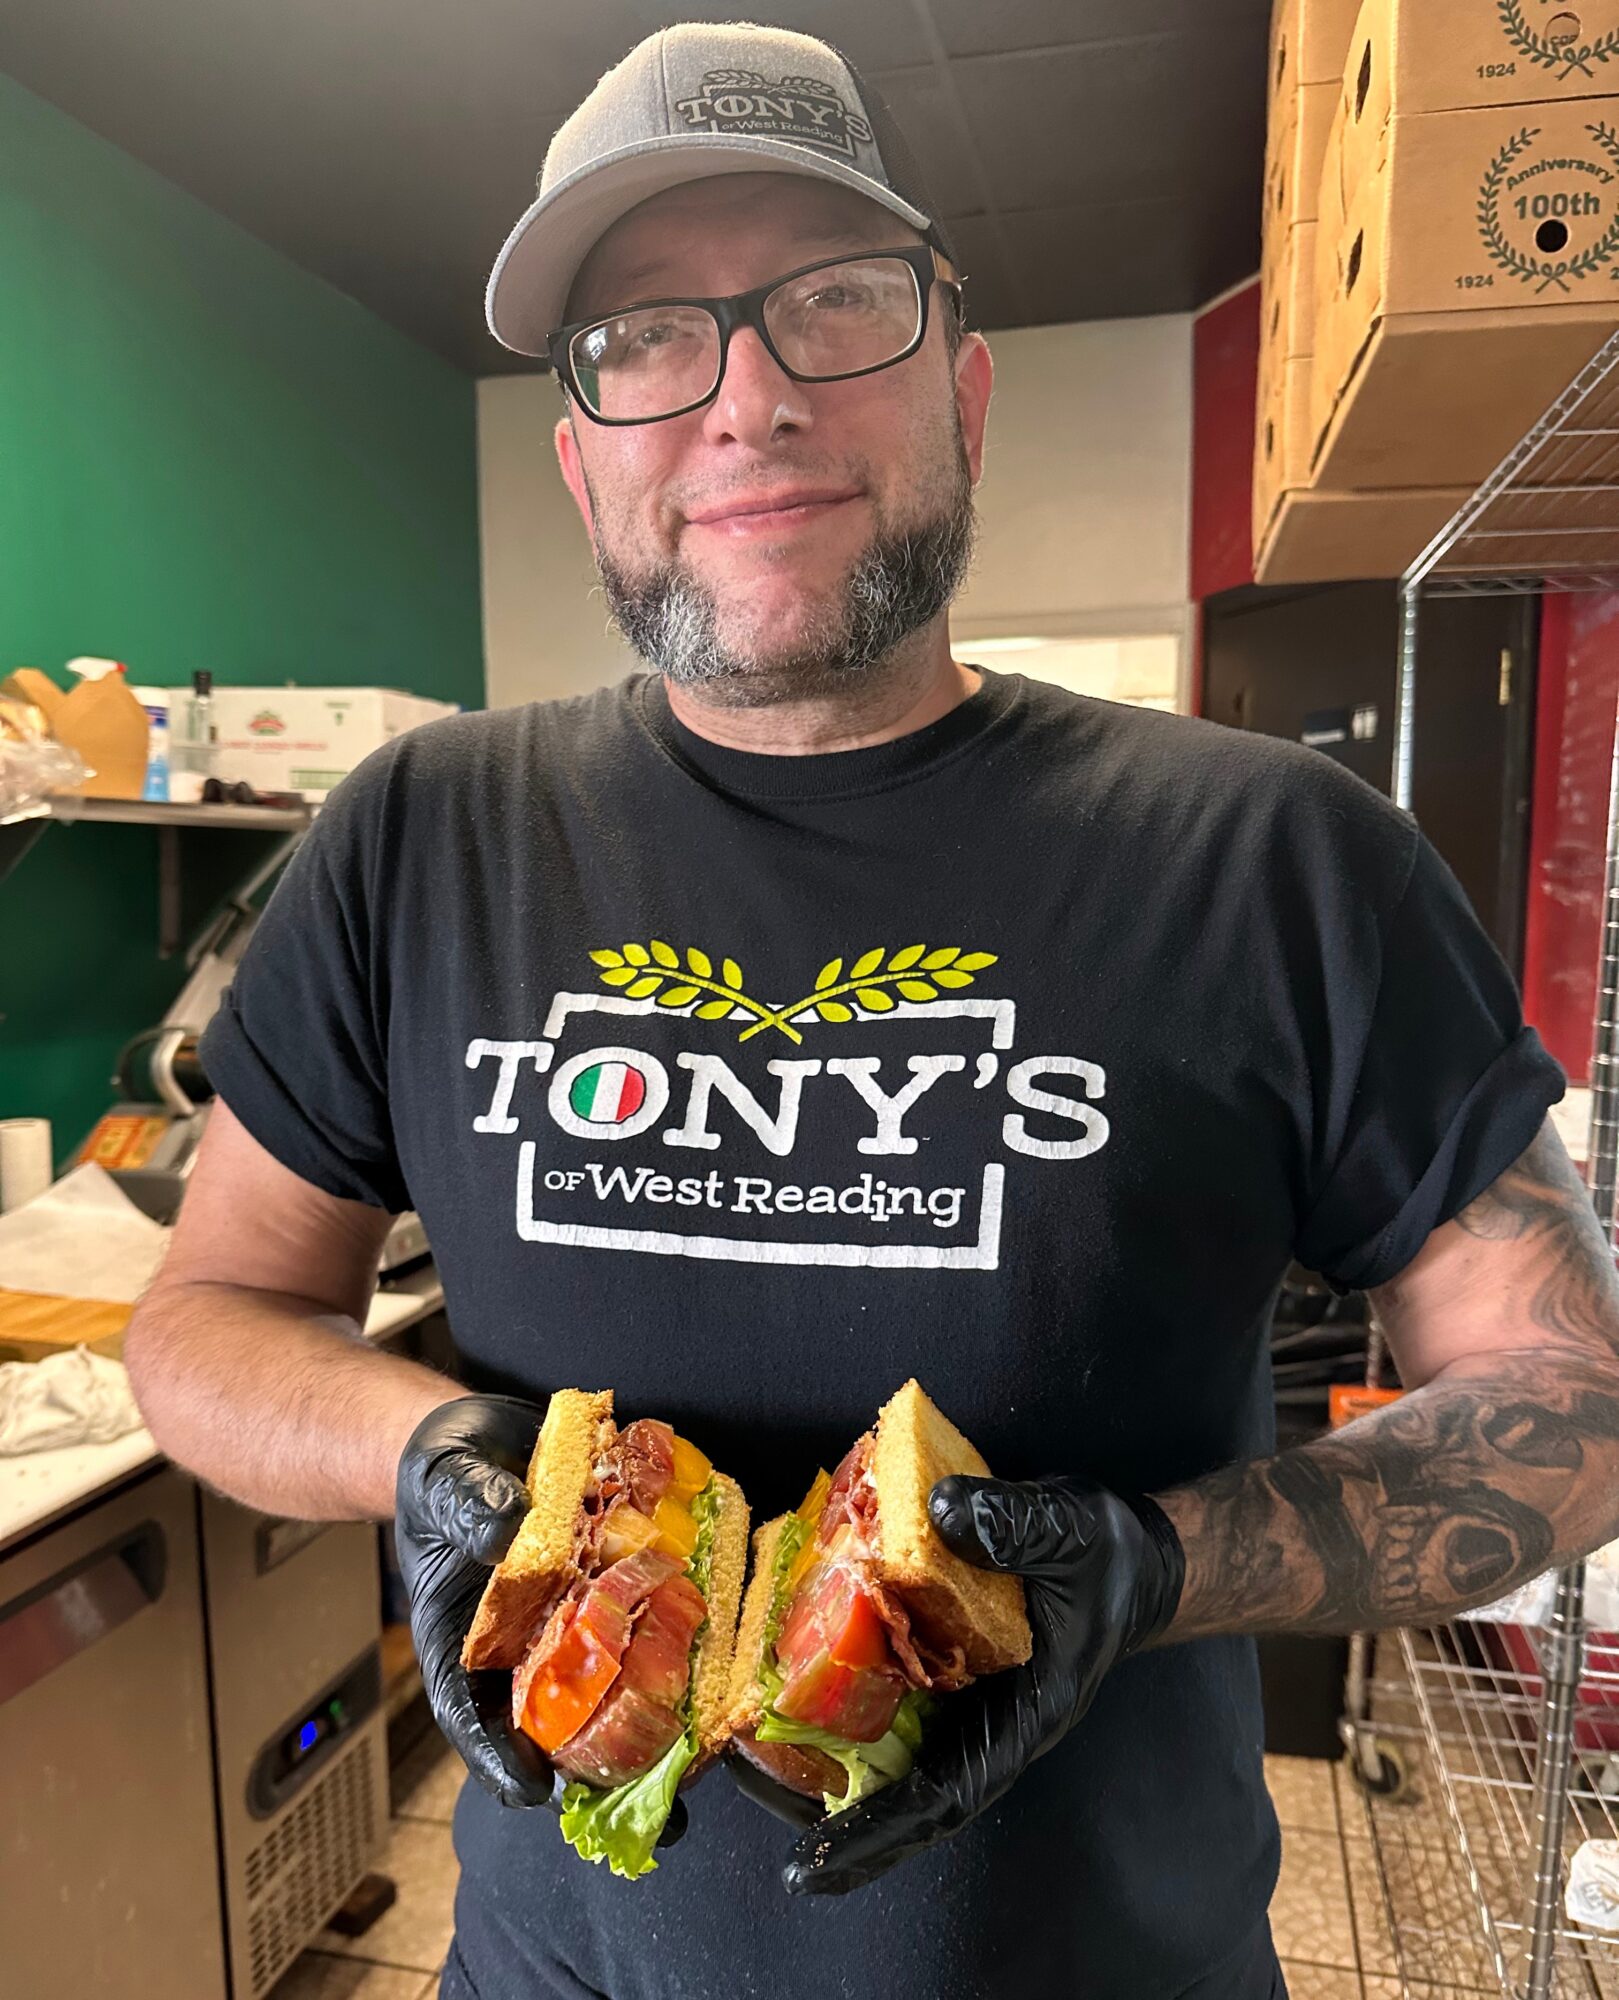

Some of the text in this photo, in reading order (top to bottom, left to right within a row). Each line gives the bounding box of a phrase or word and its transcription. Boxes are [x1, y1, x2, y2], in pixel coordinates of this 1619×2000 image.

[1476, 62, 1516, 79] 1924
[677, 94, 873, 142] TONY'S
[735, 119, 779, 131] West
[779, 120, 844, 144] Reading
[1506, 158, 1615, 191] Anniversary
[1514, 191, 1601, 220] 100th
[1455, 273, 1495, 289] 1924
[465, 1038, 1110, 1160] TONY'S
[543, 1163, 967, 1229] OF West Reading
